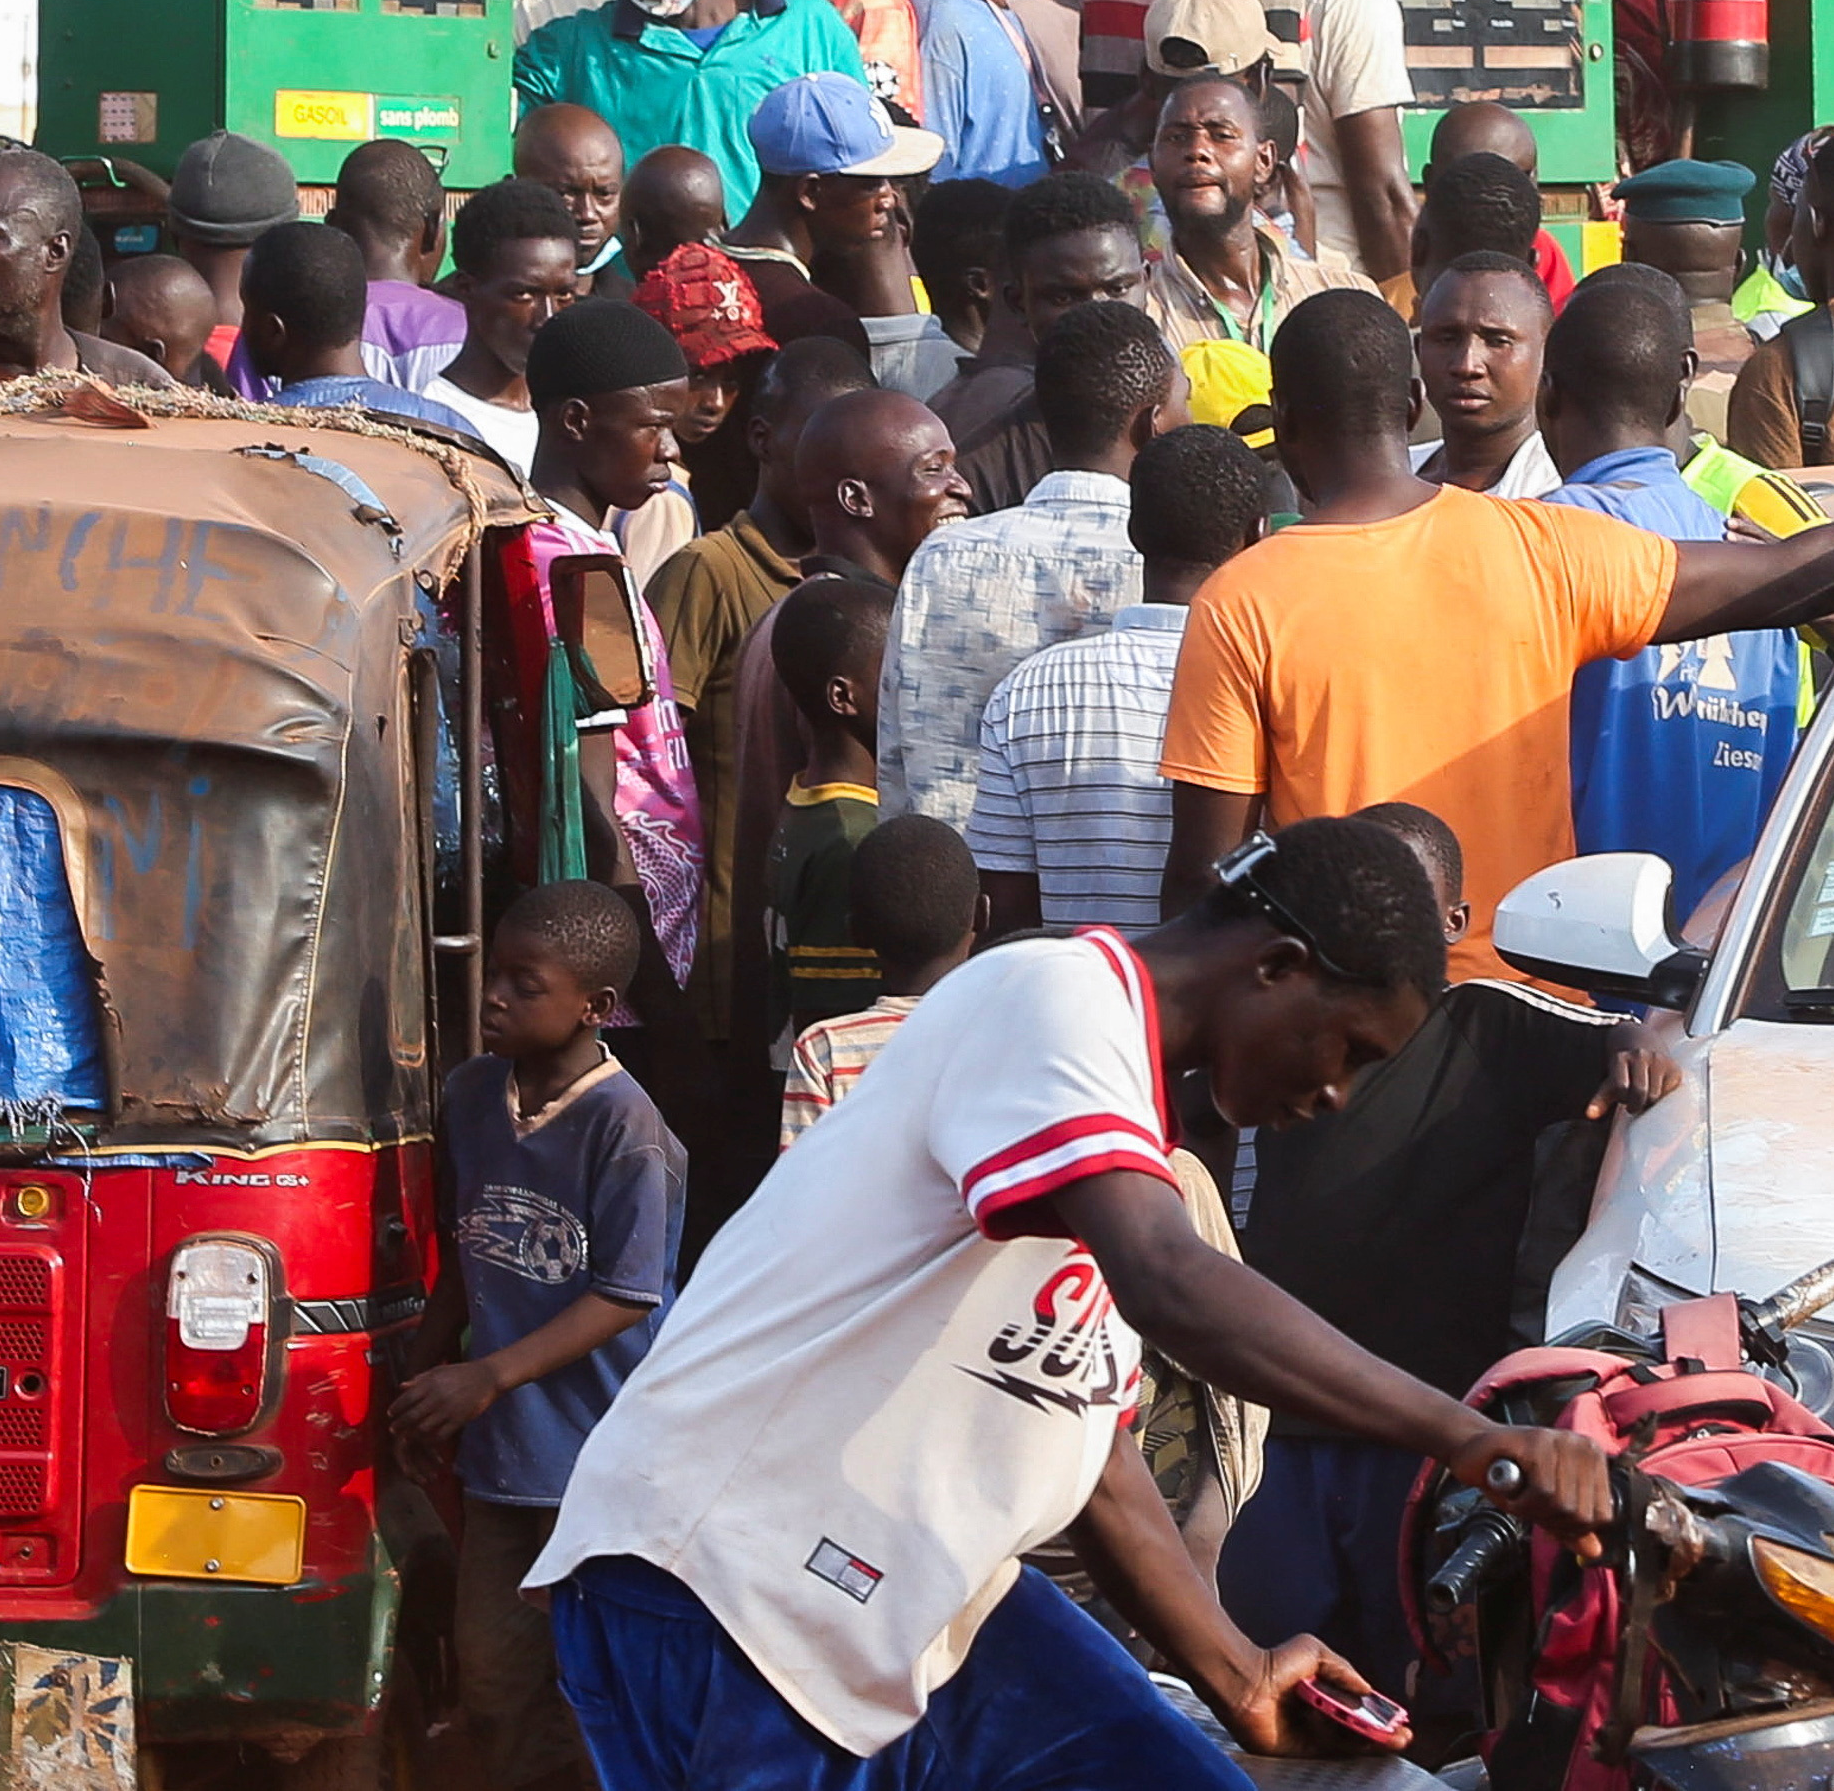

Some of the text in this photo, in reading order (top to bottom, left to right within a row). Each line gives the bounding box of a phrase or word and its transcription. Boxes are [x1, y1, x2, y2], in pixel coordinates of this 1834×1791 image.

[293, 104, 348, 126] GASOIL
[379, 106, 459, 130] sans plomb
[175, 1169, 271, 1186] KING
